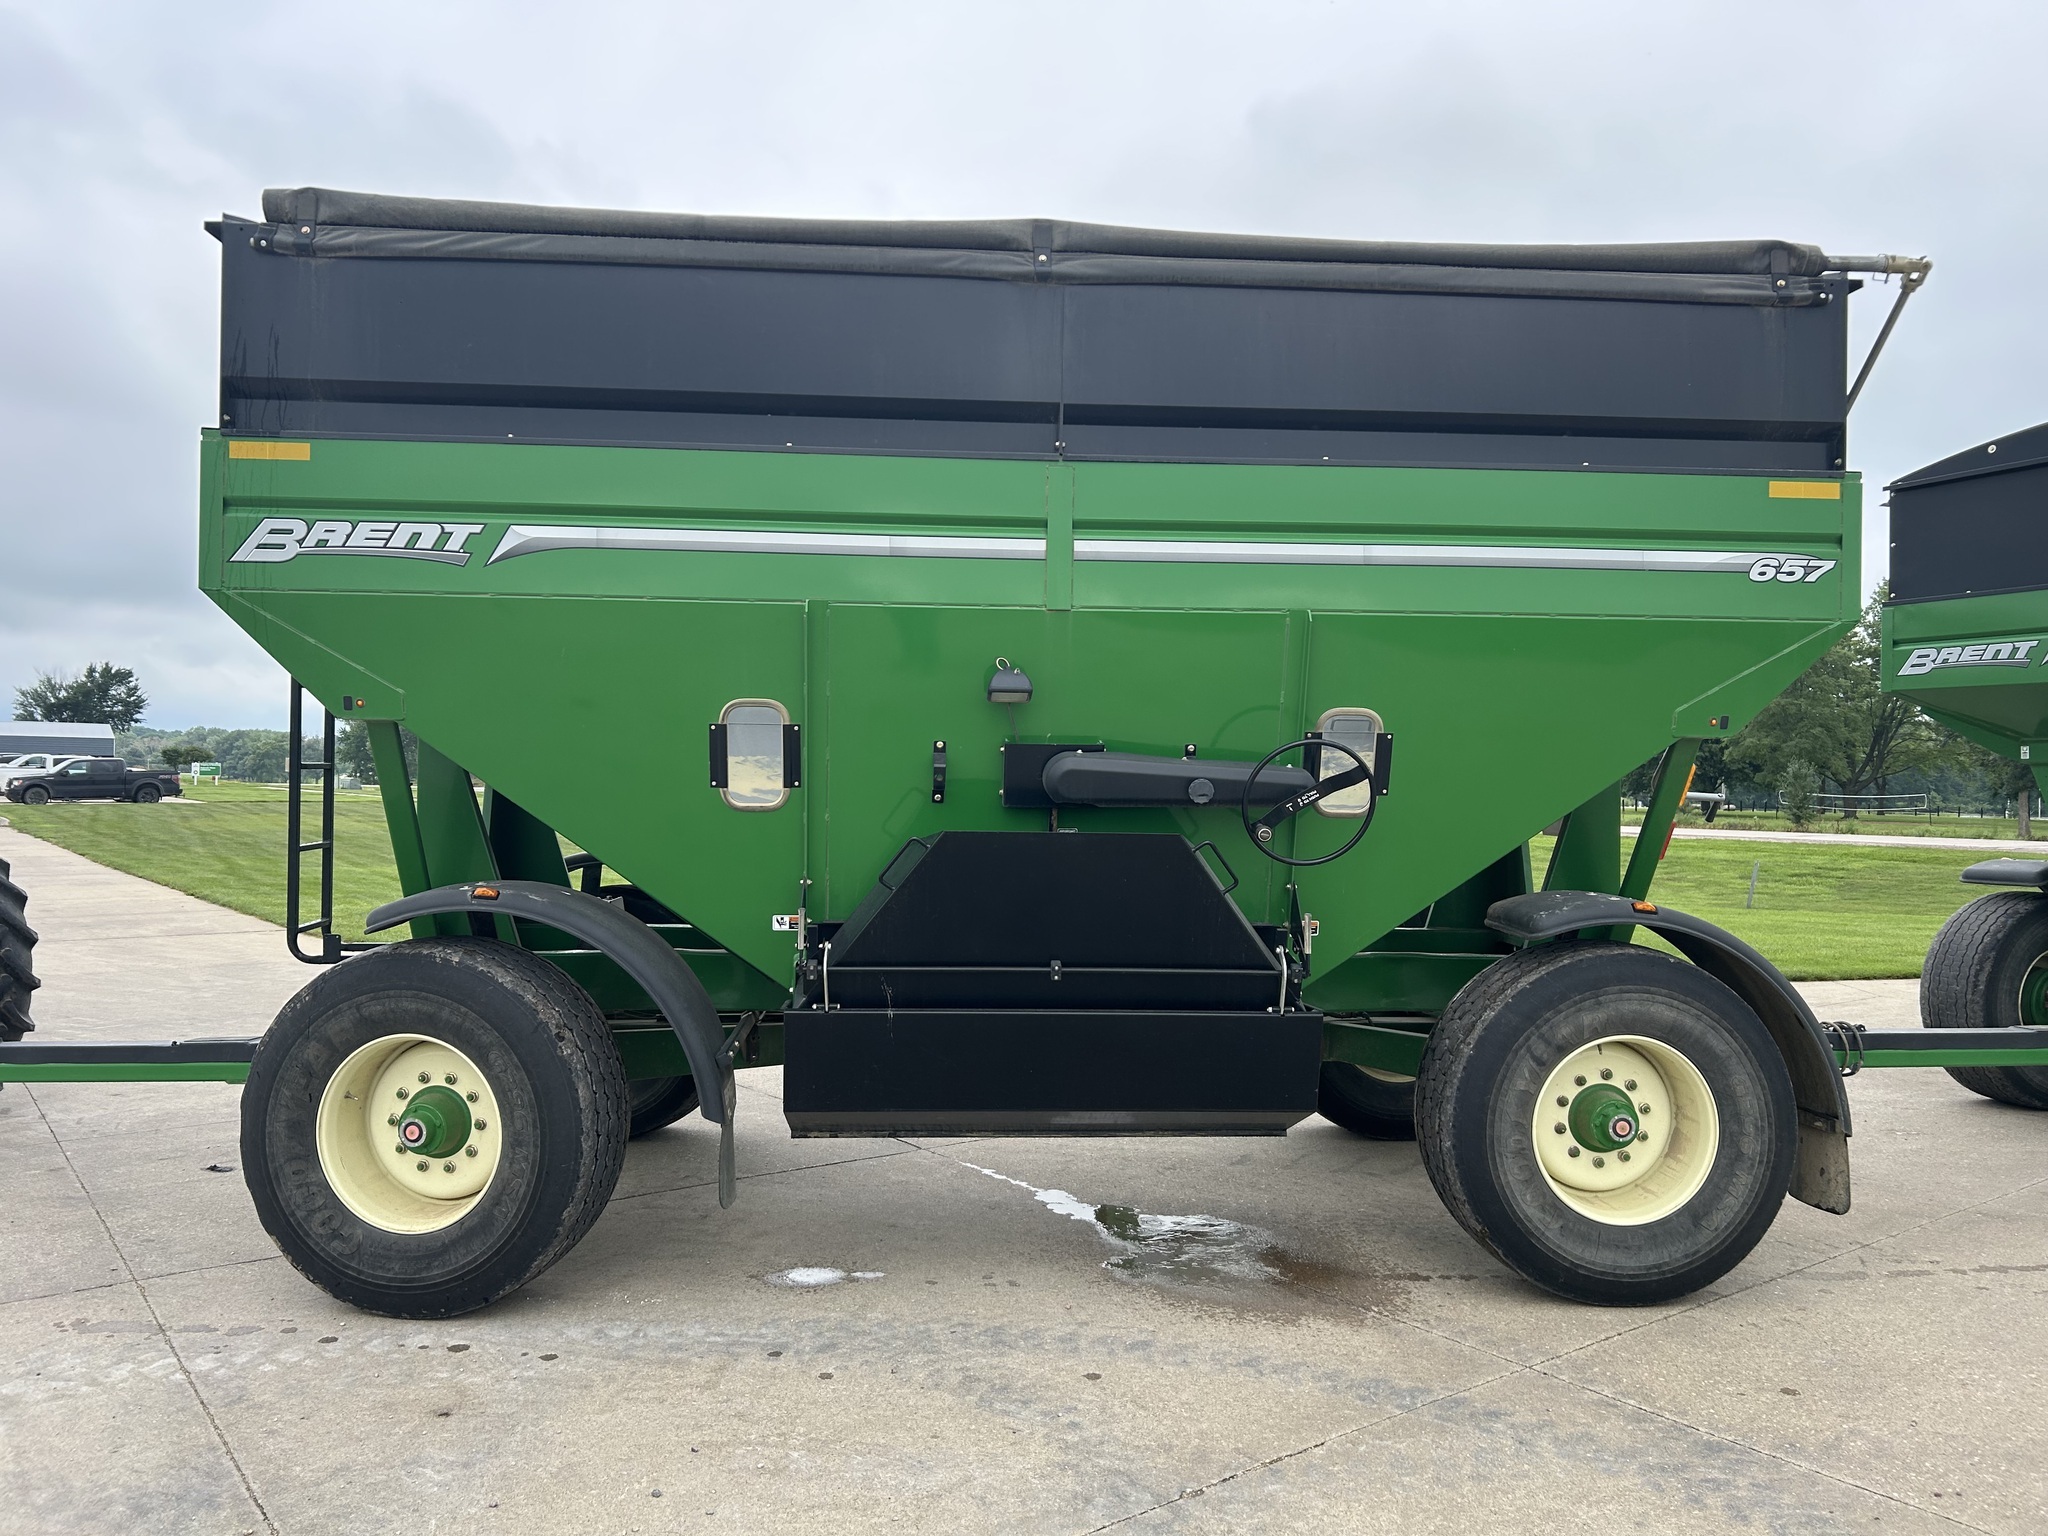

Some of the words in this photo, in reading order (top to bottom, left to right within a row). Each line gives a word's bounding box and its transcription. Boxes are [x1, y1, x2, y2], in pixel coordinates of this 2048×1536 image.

[227, 517, 488, 564] BRENT
[1749, 557, 1837, 583] 657
[1897, 640, 2040, 676] BRENT
[1701, 1170, 1750, 1233] MSA
